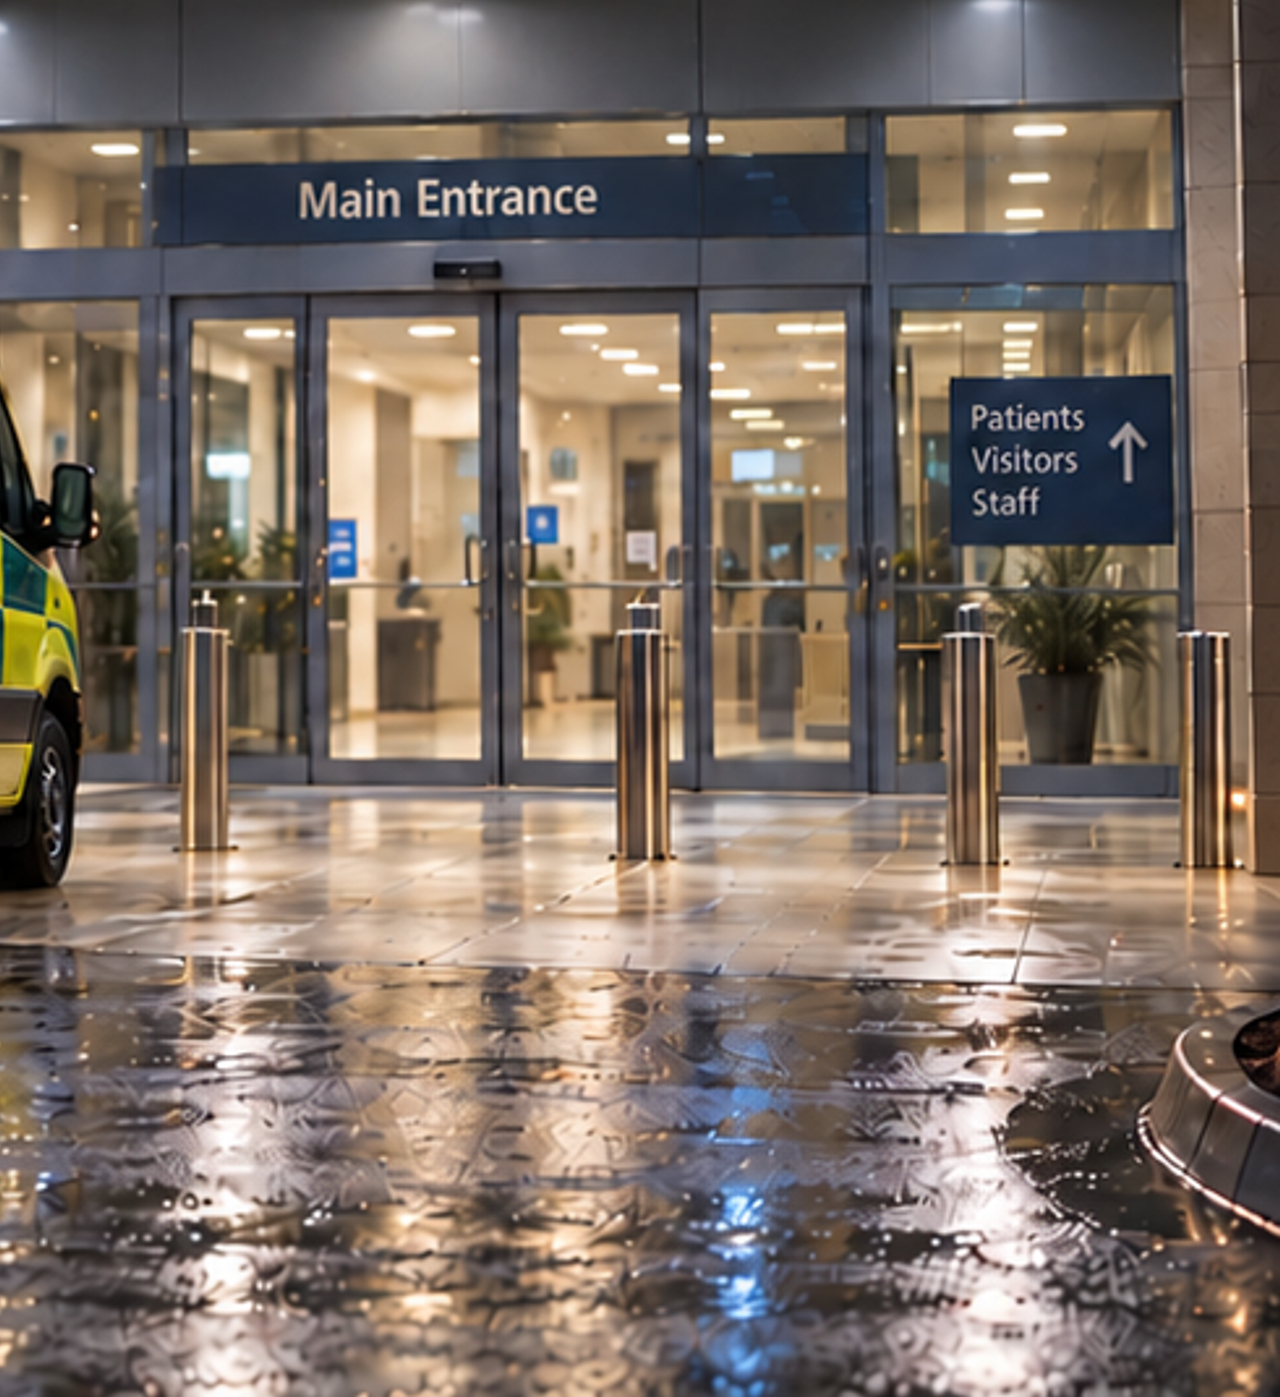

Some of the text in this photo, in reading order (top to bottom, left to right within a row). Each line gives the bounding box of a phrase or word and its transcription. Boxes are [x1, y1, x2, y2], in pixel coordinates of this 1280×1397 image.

[298, 178, 599, 219] Main Entrance
[971, 404, 1085, 432] Patients
[971, 446, 1079, 474] Visitors
[972, 487, 1041, 517] Staff
